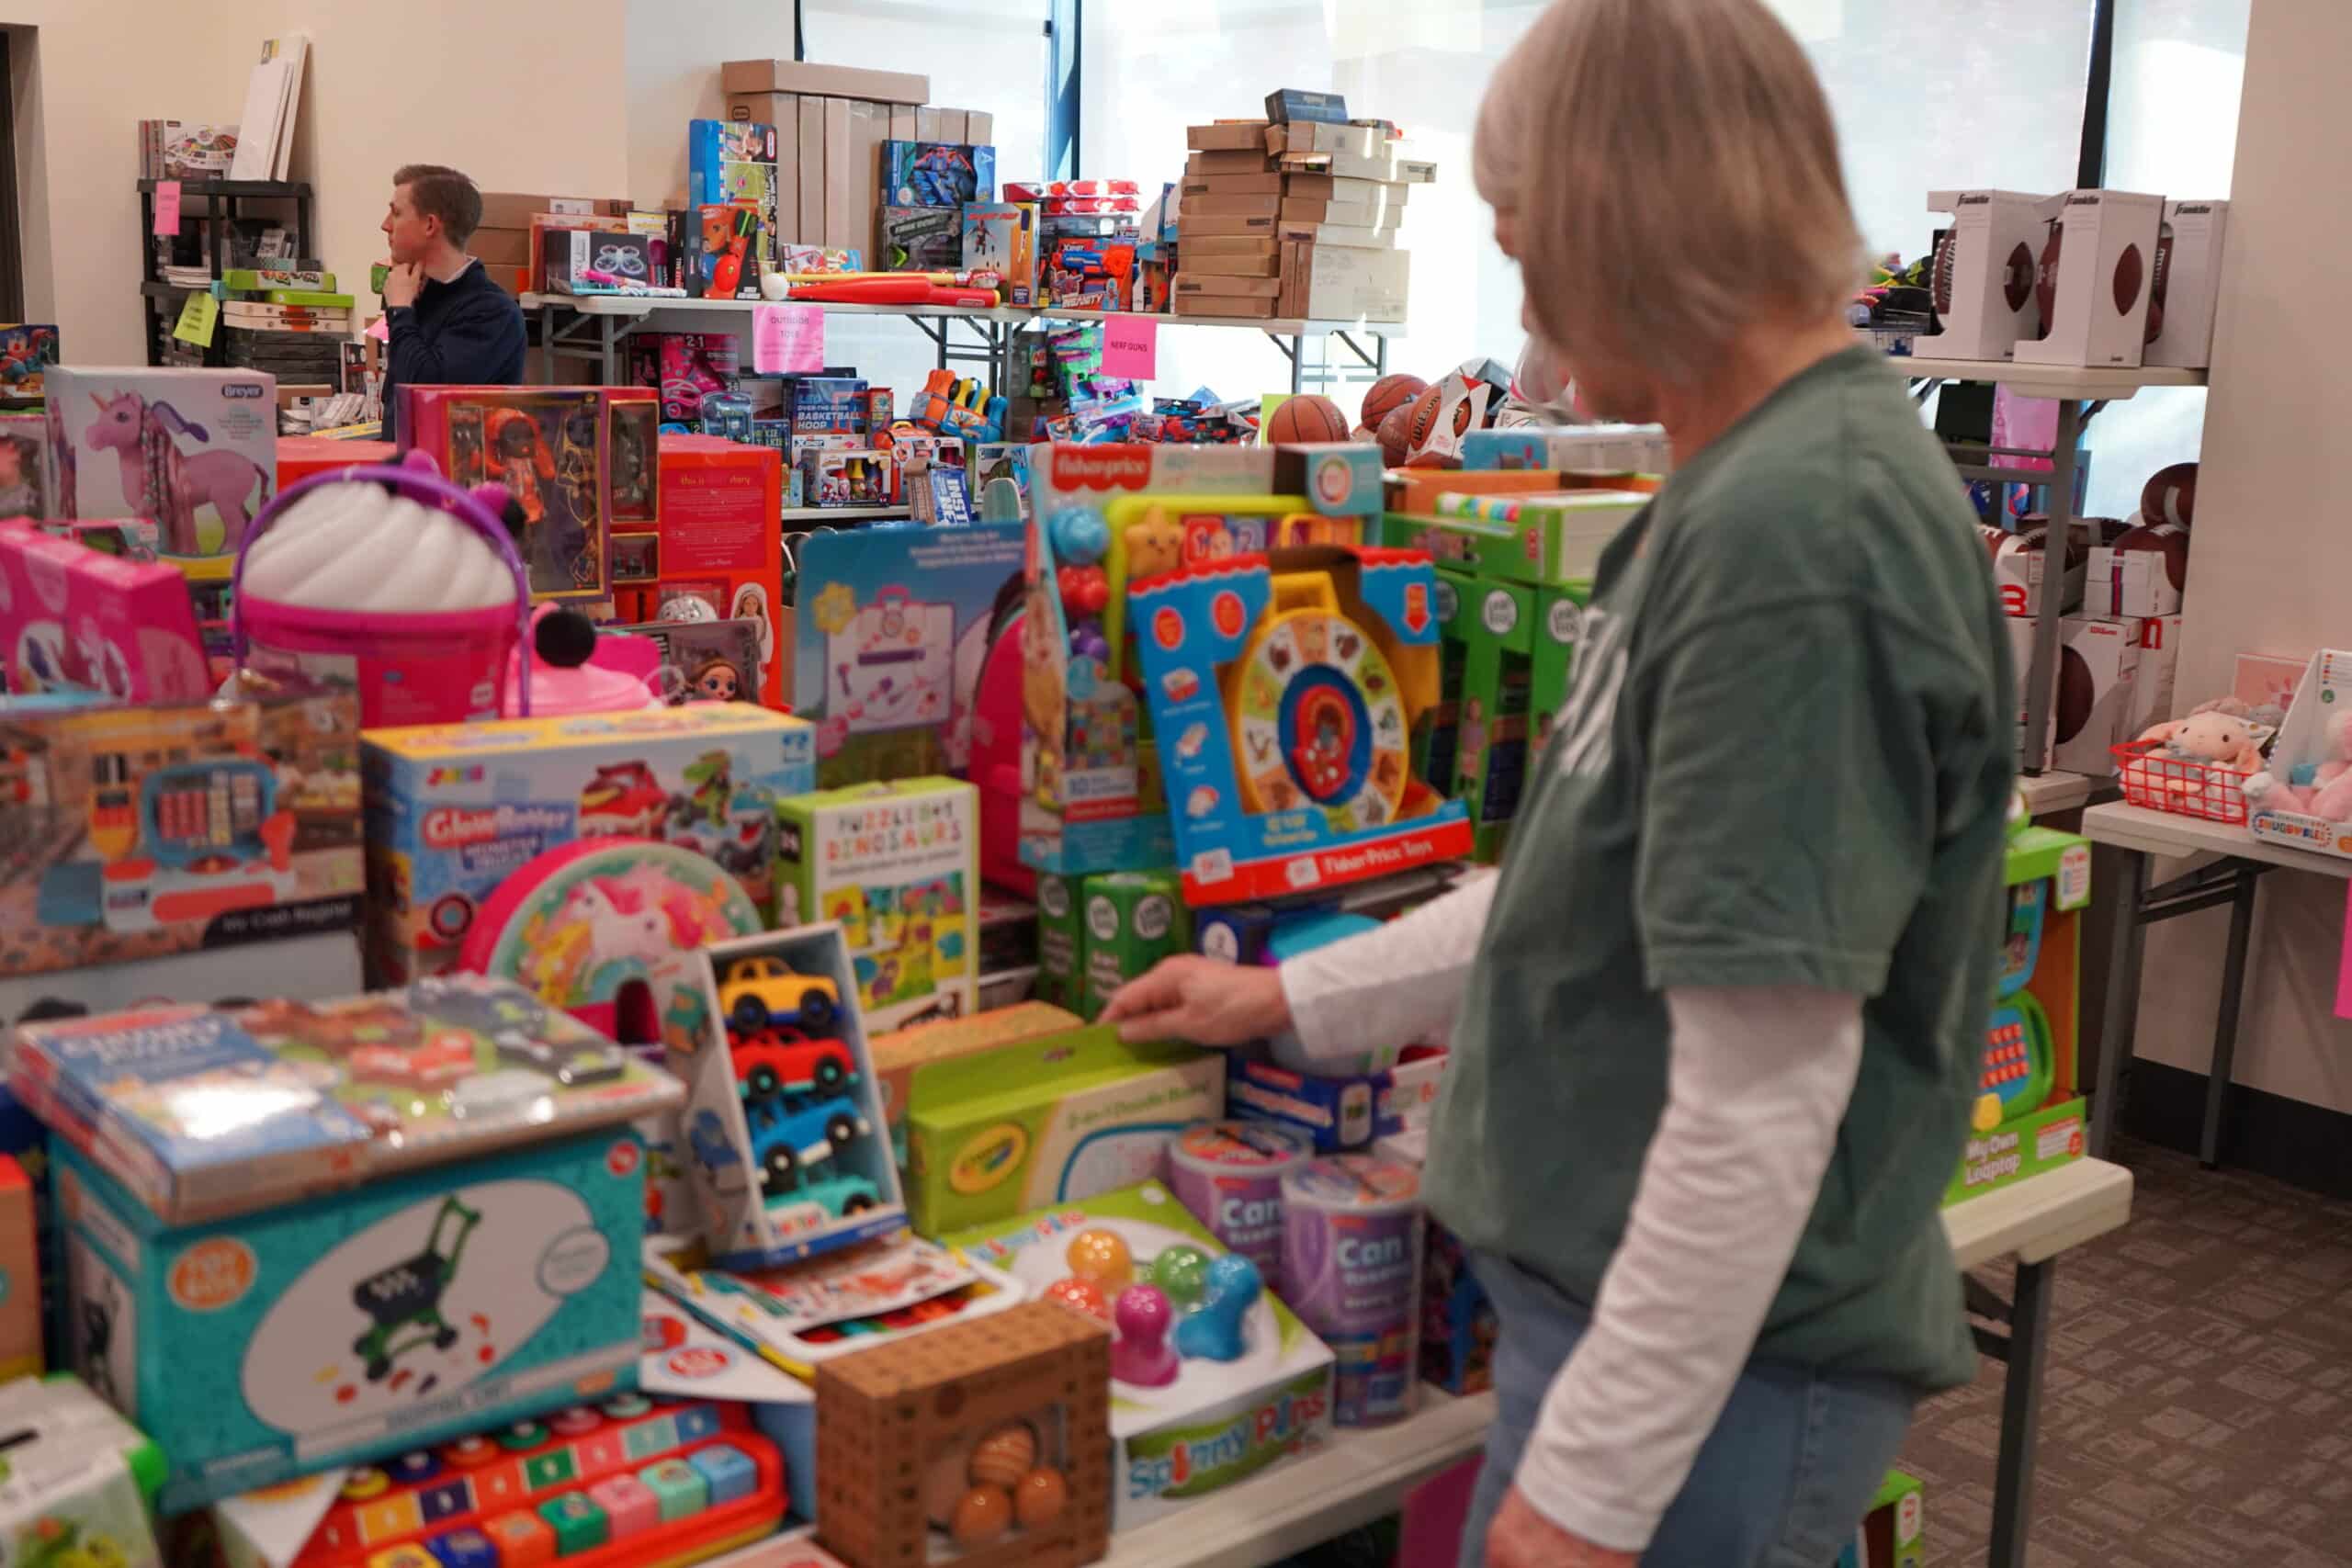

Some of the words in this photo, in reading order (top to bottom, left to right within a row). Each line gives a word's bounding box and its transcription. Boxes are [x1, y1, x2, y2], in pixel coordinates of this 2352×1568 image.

[1128, 343, 1148, 352] GUNS
[224, 386, 260, 398] Breyer
[797, 412, 861, 420] BASKETBALL
[797, 422, 827, 430] HOOP
[826, 820, 962, 862] DINOSAURS
[1402, 840, 1433, 858] Toys
[1336, 1236, 1404, 1269] Can
